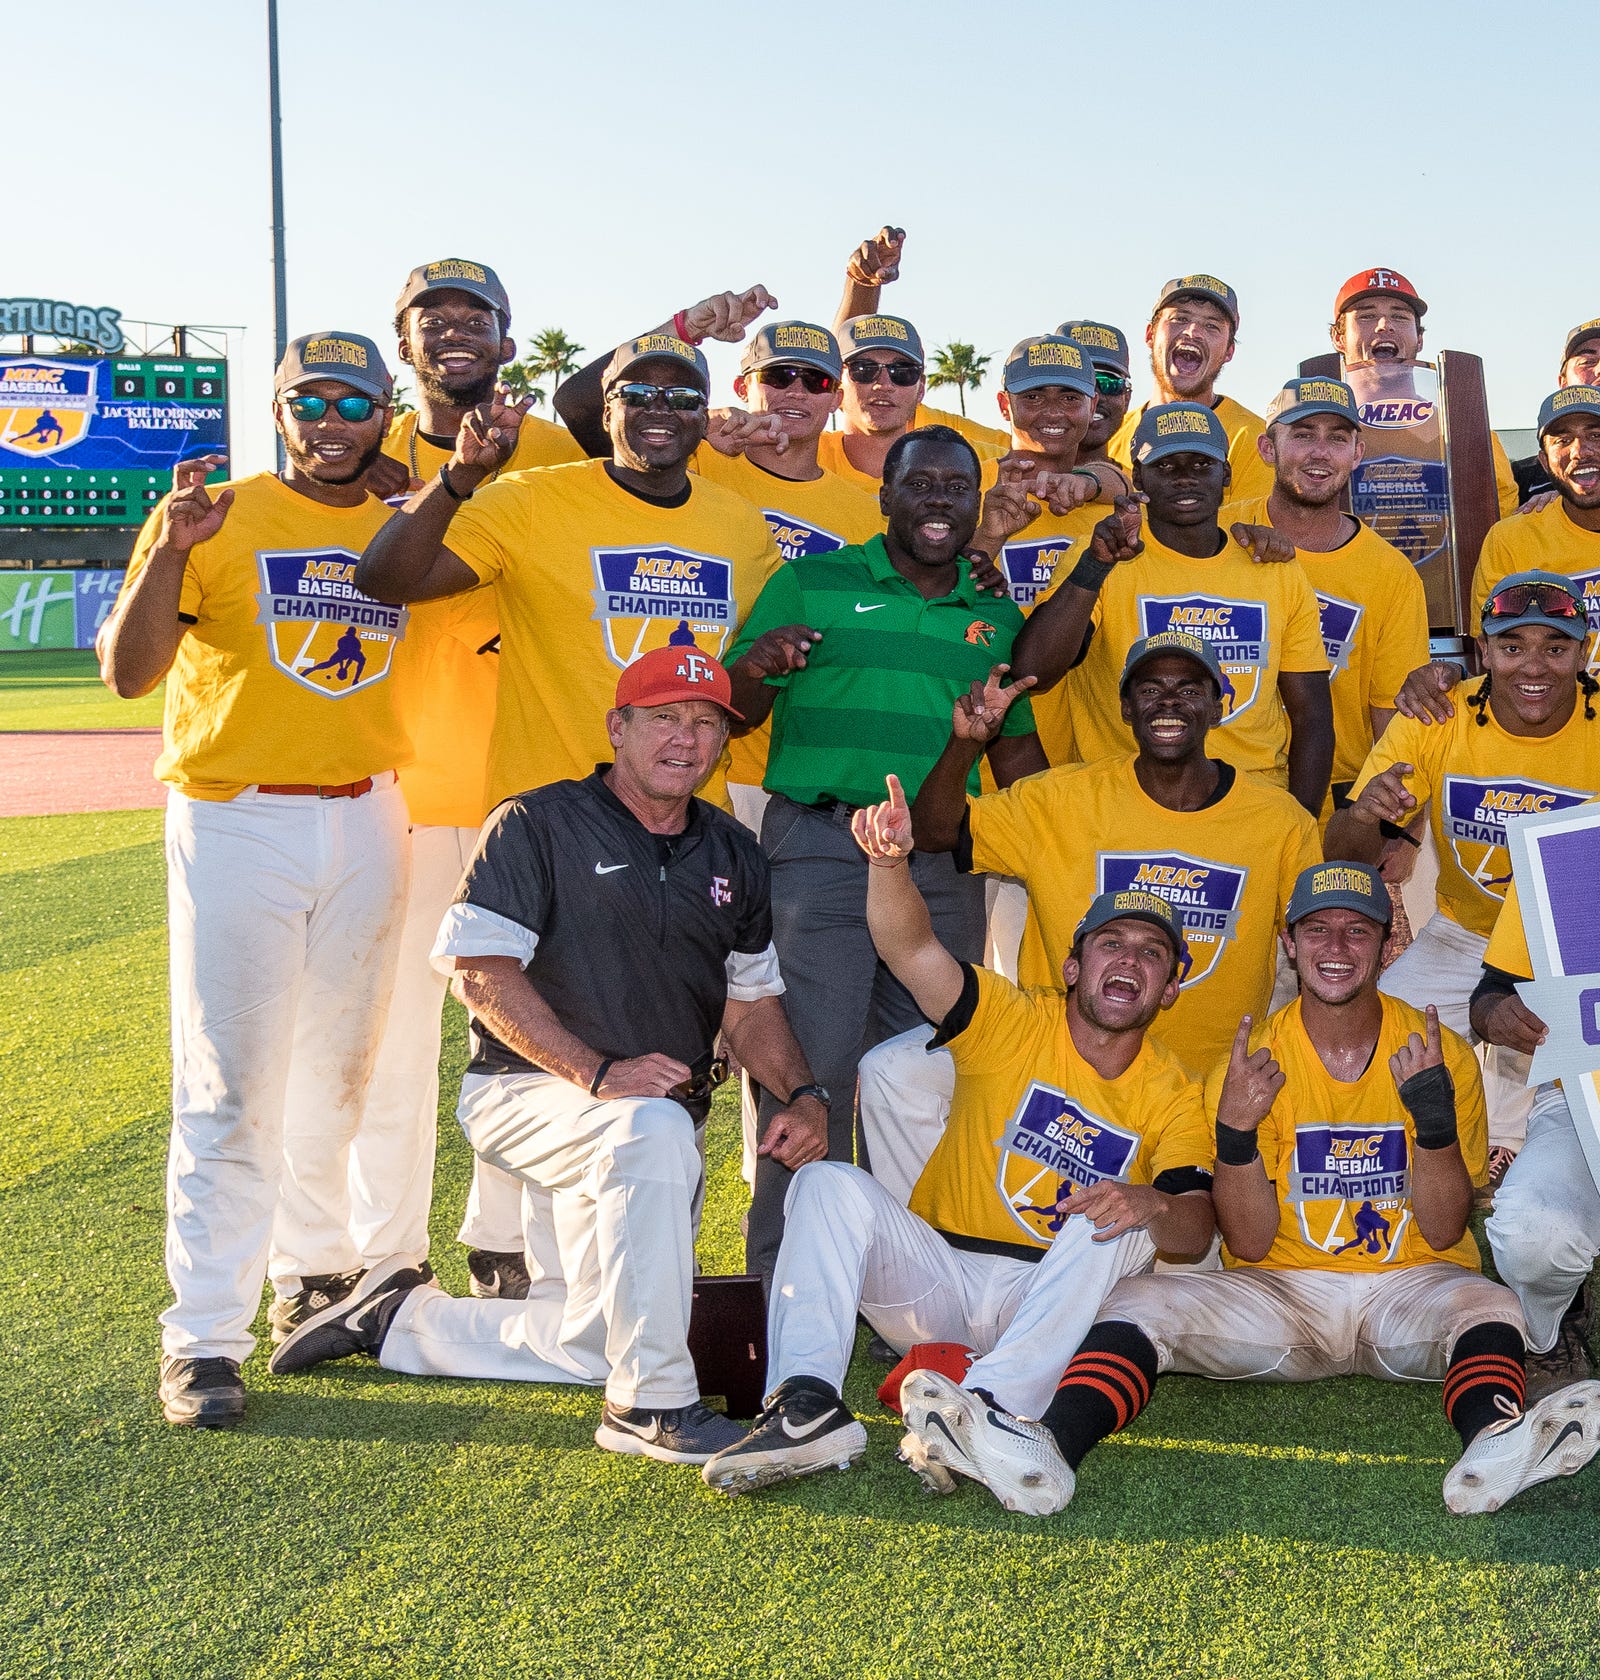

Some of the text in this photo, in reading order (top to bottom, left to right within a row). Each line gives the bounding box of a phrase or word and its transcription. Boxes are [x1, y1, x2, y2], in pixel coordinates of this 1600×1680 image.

[428, 265, 486, 283] CHAMPIONS
[777, 331, 829, 353] CHAMPIONS
[855, 322, 908, 341] CHAMPIONS
[305, 344, 367, 368] CHAMPIONS
[1029, 350, 1082, 369] CHAMPIONS
[4, 368, 65, 383] MEAC
[0, 382, 68, 394] BASEBALL
[125, 380, 213, 395] 0 0 3
[1301, 386, 1349, 408] CHAMPIONS
[1553, 392, 1600, 411] CHAMPIONS
[103, 407, 222, 420] JACKIE ROBINSON
[1363, 402, 1432, 423] MEAC
[129, 419, 198, 431] BALLPARK
[1157, 415, 1210, 436] CHAMPIONS
[766, 522, 811, 546] AC
[303, 561, 356, 582] MEA
[635, 557, 702, 580] MEAC
[630, 577, 707, 597] BASEBALL
[273, 598, 399, 629] CHAMPIONS
[608, 595, 728, 620] CHAMPIONS
[1170, 607, 1232, 626] MEAC
[360, 632, 389, 642] 2019
[693, 624, 720, 633] 2019
[1146, 635, 1203, 653] CHAMPIONS
[676, 655, 714, 683] AFM
[1480, 789, 1556, 812] MEAC
[1134, 864, 1209, 889] MEAC
[1313, 873, 1373, 895] CHAMPIONS
[1187, 933, 1214, 943] 2019
[1056, 1112, 1102, 1146] AC
[1044, 1121, 1095, 1166] BAEBALL
[1330, 1135, 1384, 1158] EAC
[1012, 1132, 1100, 1187] CHAPION
[1325, 1155, 1384, 1175] BEBALL
